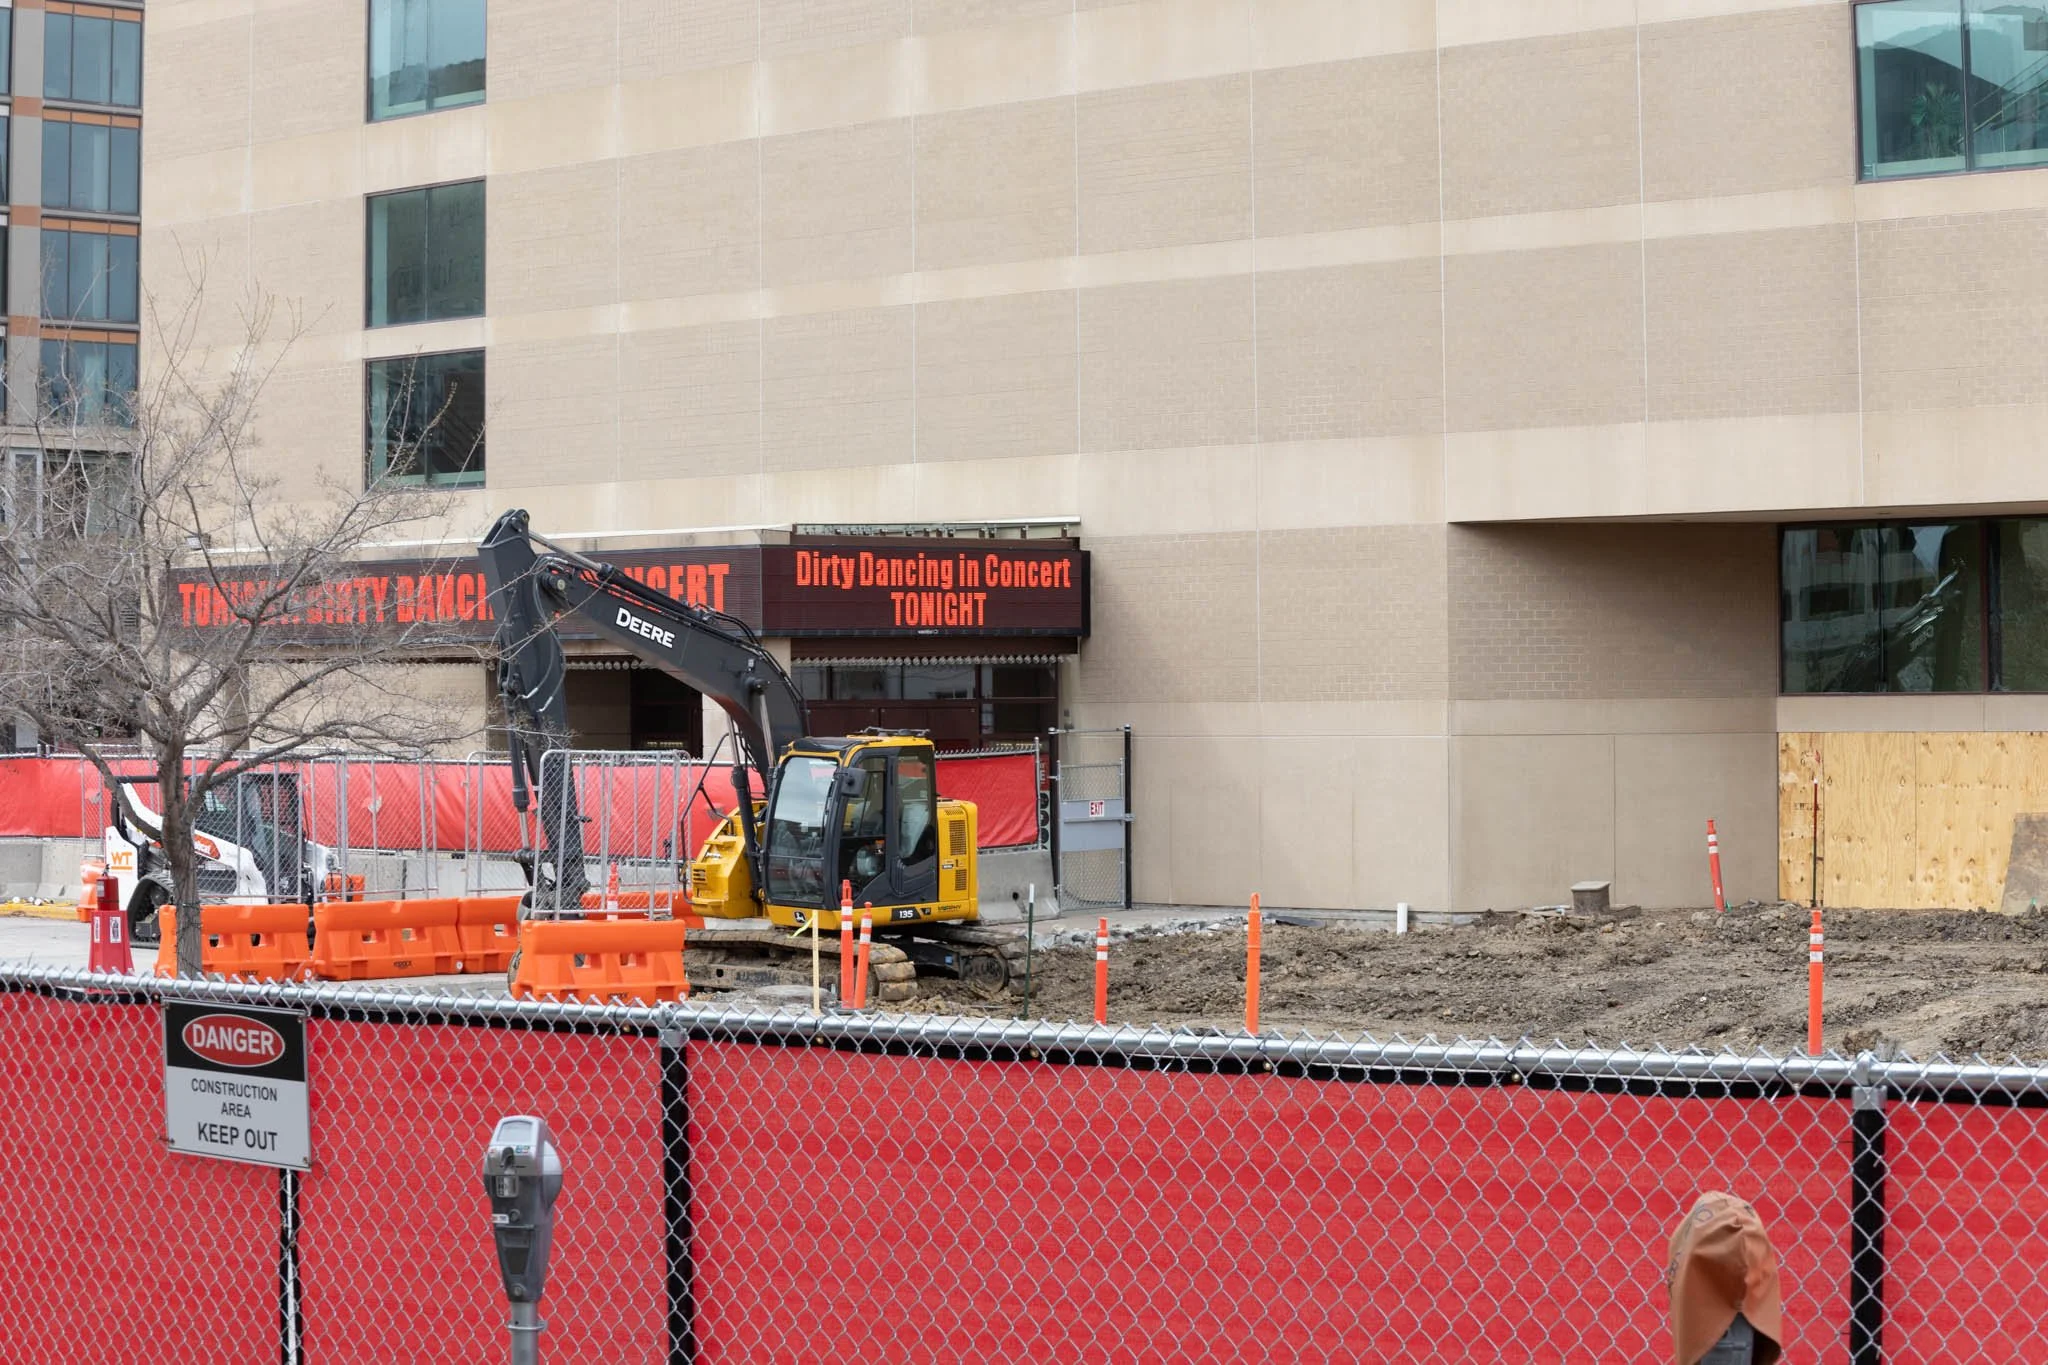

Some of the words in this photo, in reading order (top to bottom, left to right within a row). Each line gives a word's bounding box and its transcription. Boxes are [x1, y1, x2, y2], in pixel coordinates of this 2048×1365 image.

[796, 550, 855, 589] Dirty
[860, 551, 953, 589] Dancing
[959, 553, 979, 587] in
[985, 553, 1071, 588] Concert
[397, 573, 495, 622] DANCI
[580, 563, 730, 613] CERT
[890, 592, 987, 626] TONIGHT
[615, 607, 675, 649] DEERE
[1090, 802, 1104, 816] EXIT
[111, 852, 133, 865] WT
[898, 909, 914, 919] 135
[192, 1023, 276, 1056] DANGER
[191, 1078, 278, 1102] CONSTRUCTION
[221, 1102, 252, 1118] AREA
[198, 1121, 239, 1146] KEEP
[244, 1128, 278, 1152] OUT
